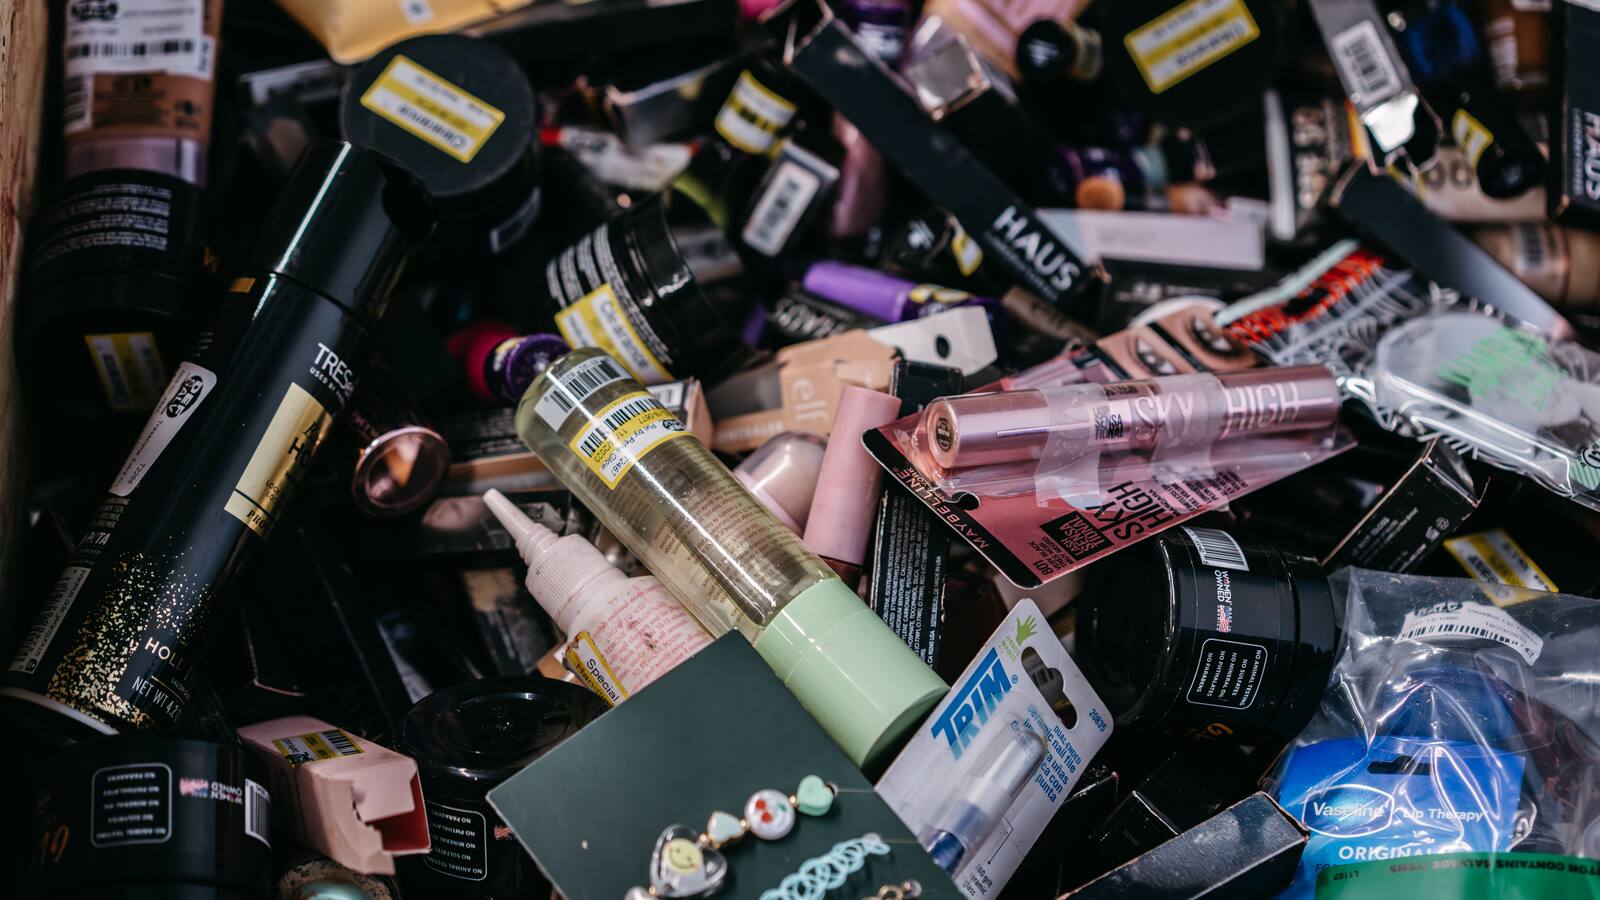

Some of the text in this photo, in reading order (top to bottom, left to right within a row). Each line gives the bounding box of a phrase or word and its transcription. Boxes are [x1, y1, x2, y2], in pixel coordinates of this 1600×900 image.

[993, 205, 1080, 291] HAUS
[175, 380, 202, 416] DEF
[1134, 381, 1302, 441] SKY HIGH
[1094, 413, 1124, 429] SENSA
[1094, 424, 1125, 441] TIONAL
[594, 429, 630, 464] 11//2023
[599, 452, 618, 472] Glow
[896, 467, 989, 550] MAYBELLINE
[1107, 480, 1175, 529] HIGH
[1149, 488, 1180, 516] MASCARA
[1069, 513, 1104, 545] TIONAL
[1086, 500, 1145, 541] SKY
[1057, 521, 1094, 550] SENSA
[1059, 537, 1084, 554] LASH
[1033, 560, 1053, 576] 801
[1047, 557, 1061, 570] VERY
[1214, 570, 1224, 601] OWNED
[145, 637, 186, 671] HOLD
[1230, 652, 1236, 662] NO
[587, 659, 620, 702] Special
[1196, 652, 1213, 692] NO PARABENS
[1206, 650, 1225, 697] NO PHTHALATES
[1222, 662, 1234, 688] MINERAL
[1231, 658, 1247, 695] NO SULFATES
[1239, 649, 1261, 706] NO ANIMAL TESTING
[132, 675, 152, 694] NET
[154, 684, 170, 704] WT
[931, 648, 1012, 761] TRIM
[1089, 708, 1108, 733] 20835
[1027, 704, 1076, 774] ceramic nail file
[1054, 725, 1082, 765] DUAL-ENDED
[1049, 774, 1063, 794] con
[1052, 760, 1069, 785] uñas
[211, 781, 242, 796] OWNED
[1035, 774, 1057, 803] punta
[1313, 802, 1385, 818] Vaseline
[1428, 808, 1485, 823] Therapy
[440, 837, 465, 848] MINERAL
[448, 863, 471, 873] ANIMAL
[472, 867, 482, 875] NO
[1496, 859, 1566, 873] CONTAINS
